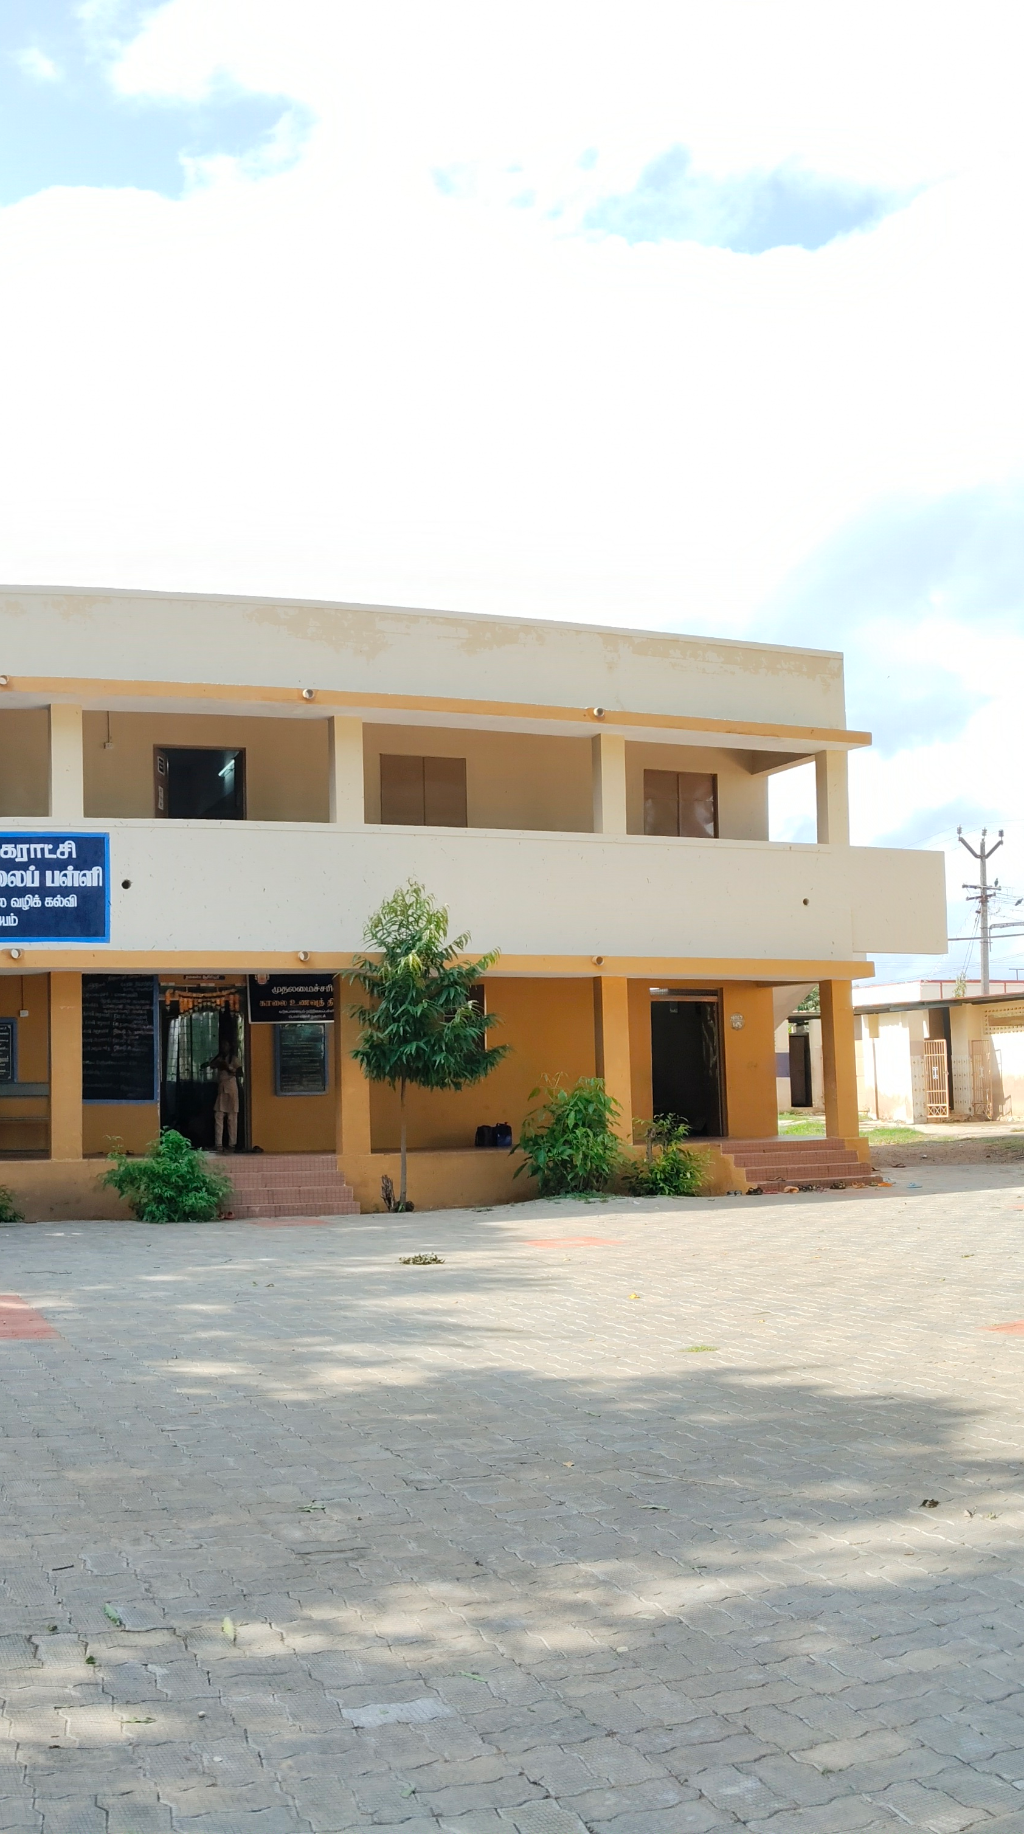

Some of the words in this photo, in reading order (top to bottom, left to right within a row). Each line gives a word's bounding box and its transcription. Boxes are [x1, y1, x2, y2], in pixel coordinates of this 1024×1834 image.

[45, 865, 103, 888] பள்ளி
[10, 894, 41, 911] வழிக்
[44, 894, 78, 908] கல்வி
[271, 983, 334, 995] முதலமைச்சரி
